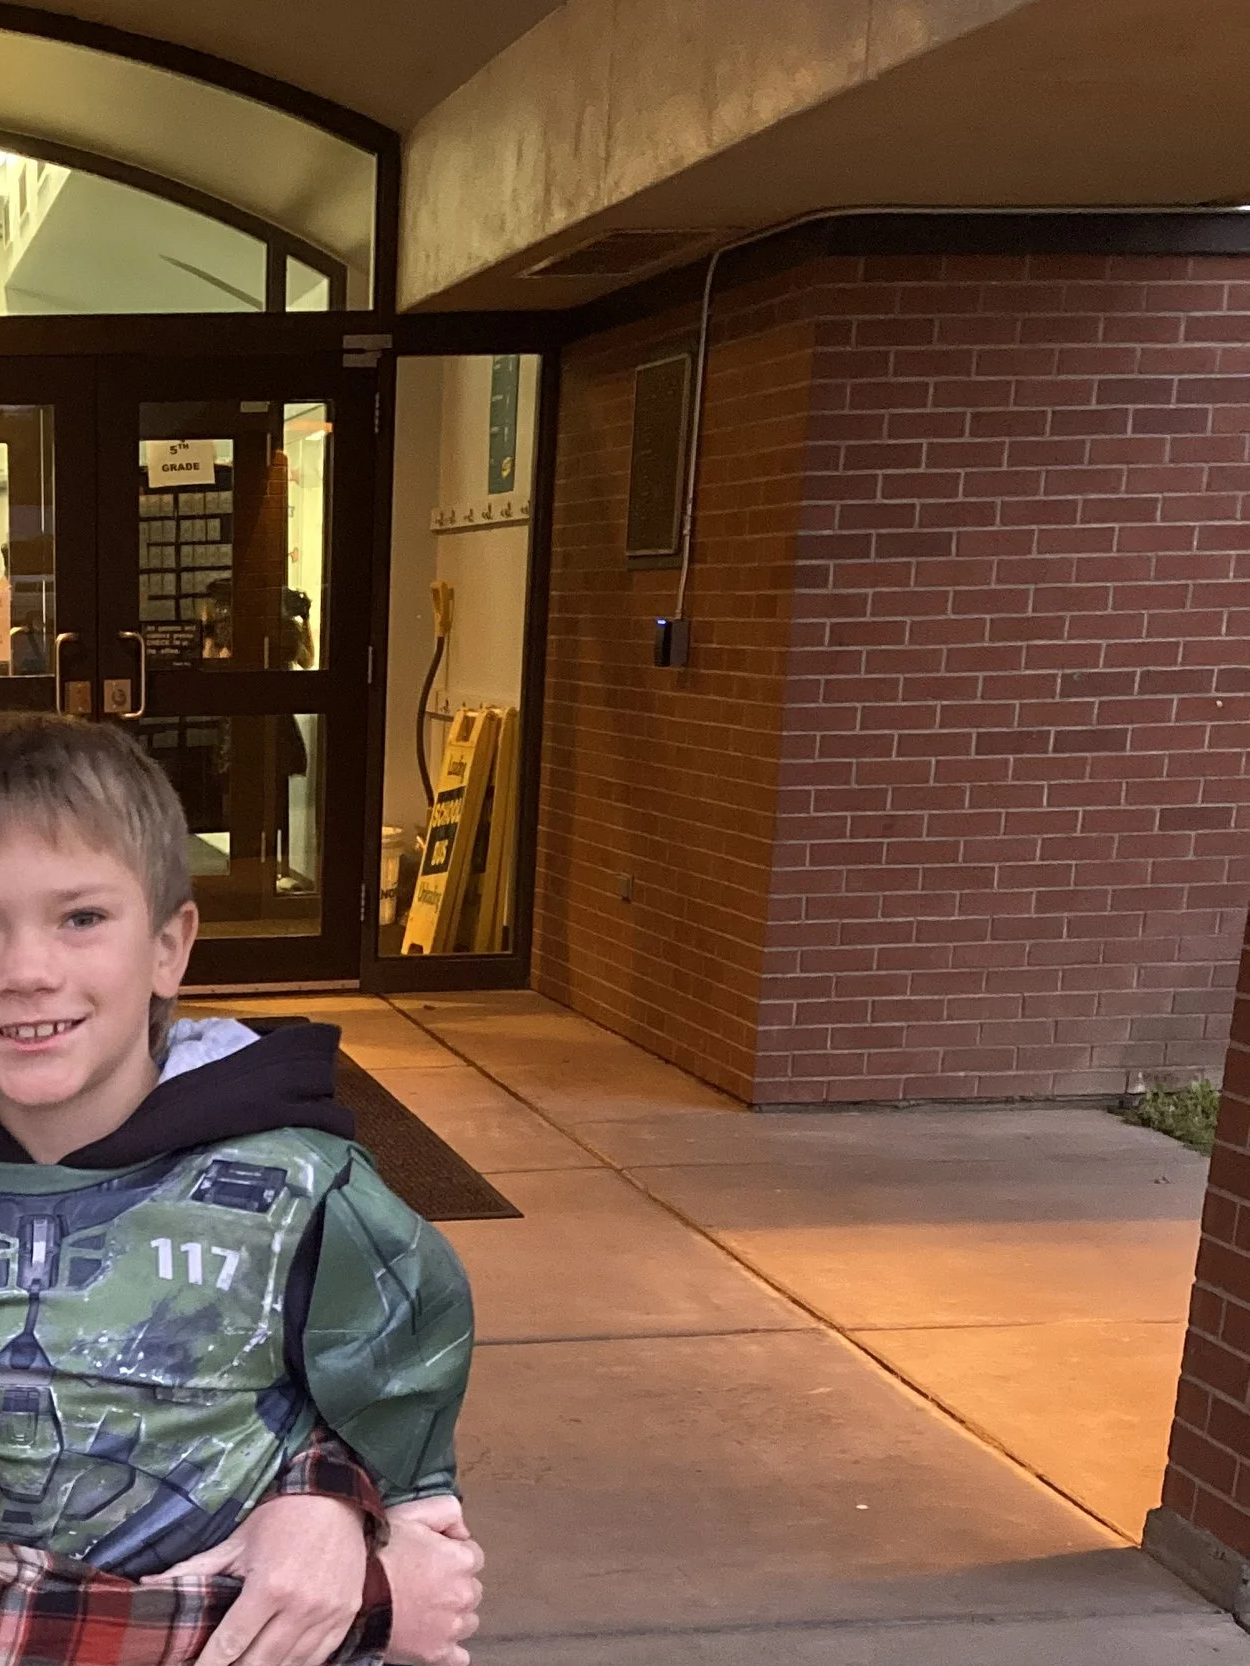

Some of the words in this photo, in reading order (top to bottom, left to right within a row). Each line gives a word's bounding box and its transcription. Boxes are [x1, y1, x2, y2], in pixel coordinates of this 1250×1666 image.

[161, 462, 201, 472] GRADE
[432, 798, 464, 828] SCHOOL
[150, 1237, 240, 1291] 117
